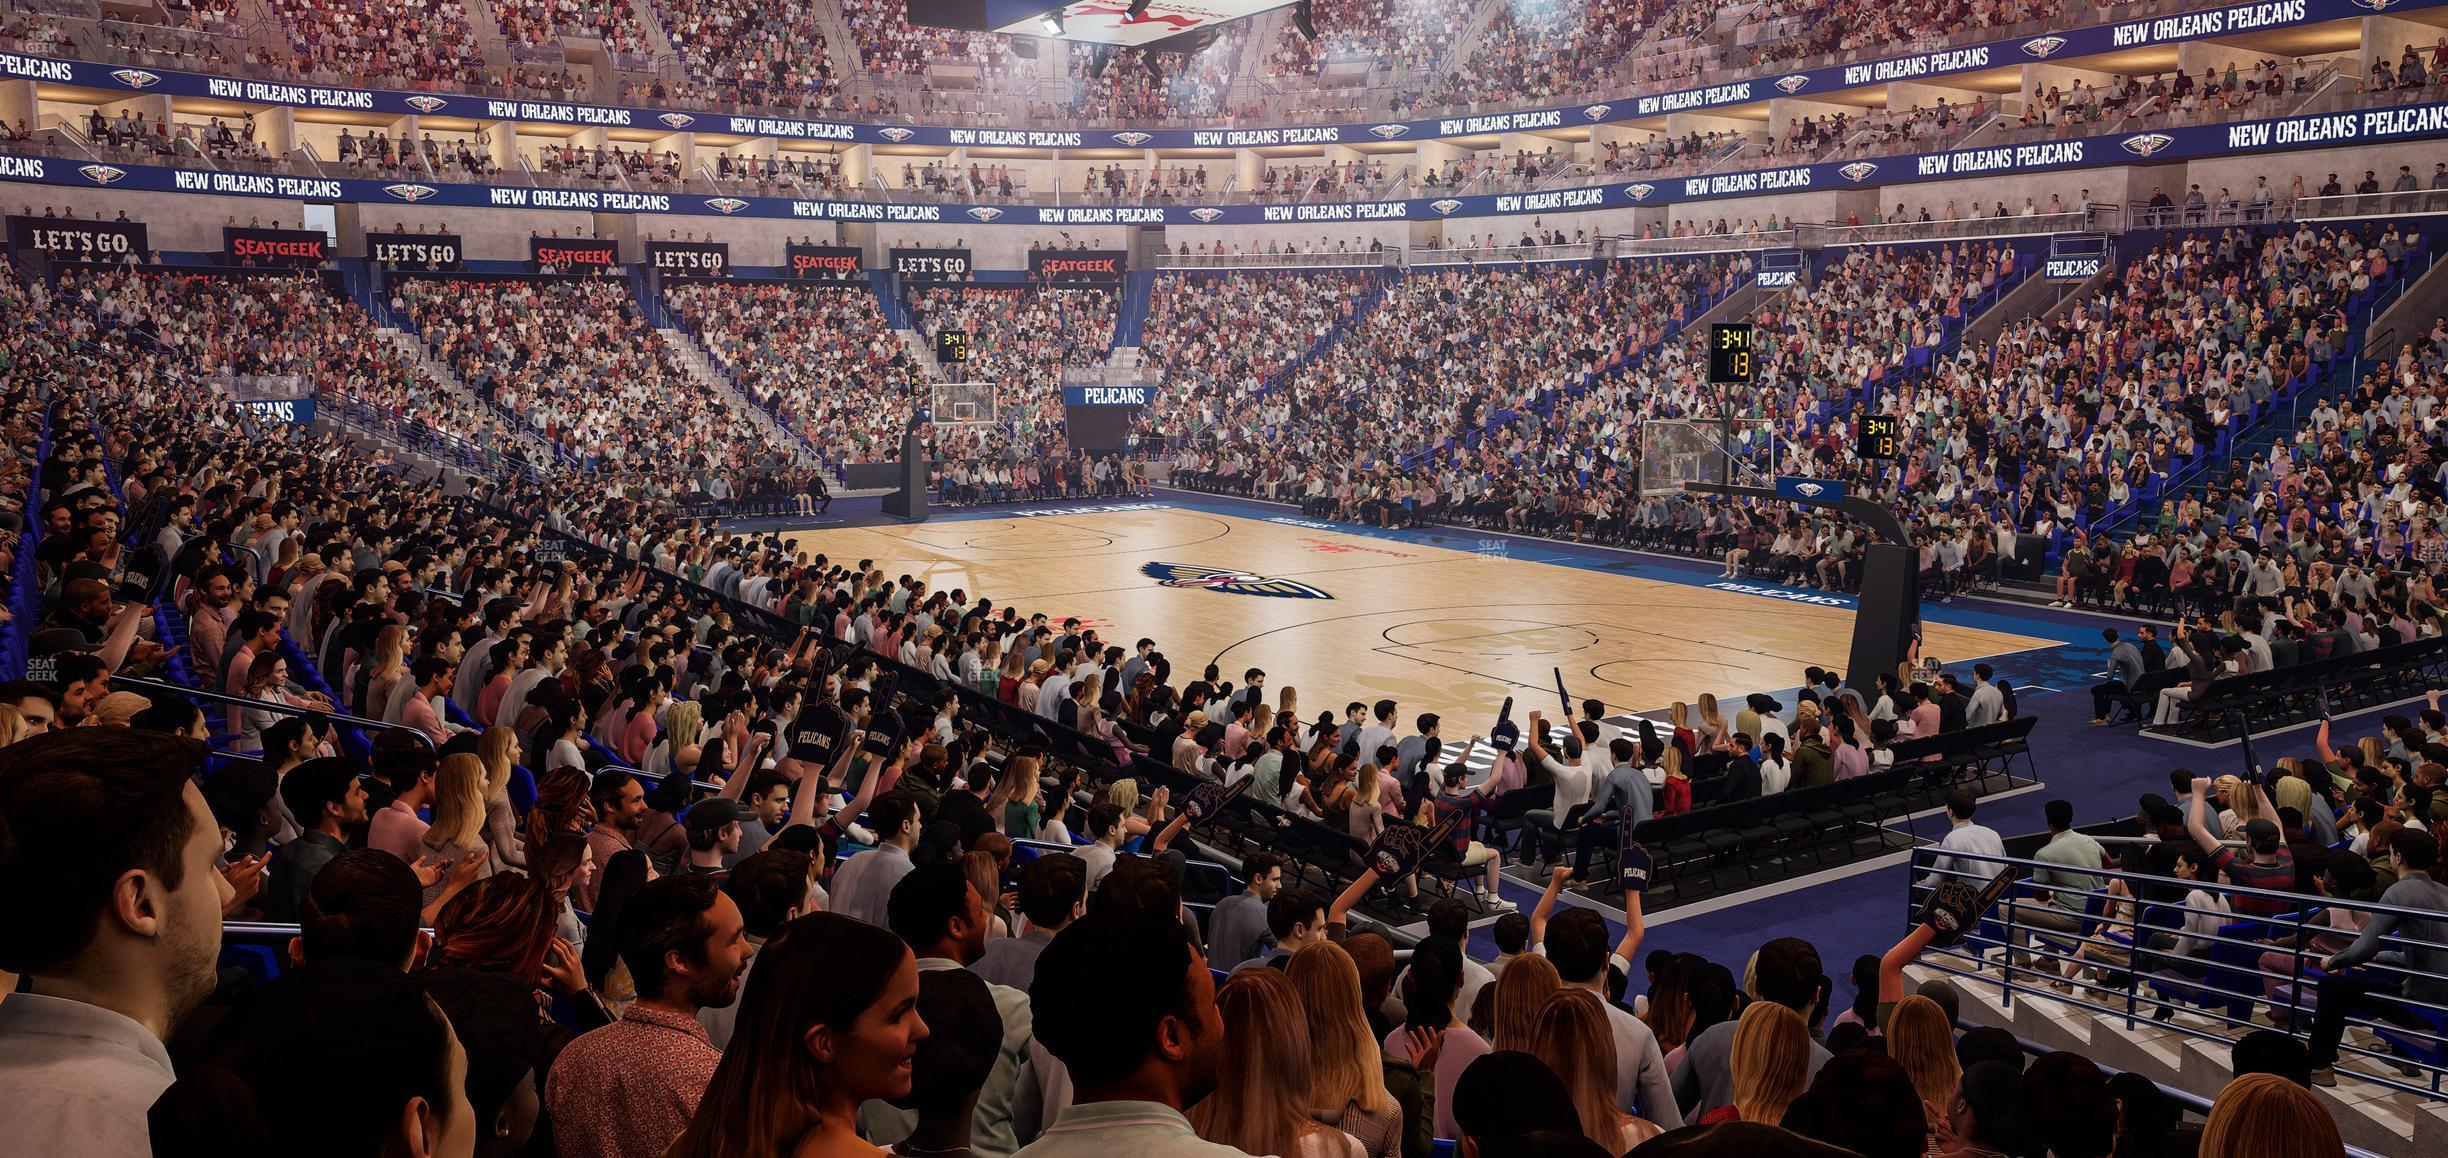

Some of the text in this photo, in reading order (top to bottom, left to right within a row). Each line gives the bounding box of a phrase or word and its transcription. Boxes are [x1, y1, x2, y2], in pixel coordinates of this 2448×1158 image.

[2113, 0, 2306, 47] NEW ORLEANS PELICANS
[1844, 46, 1989, 85] NEW ORLEANS PELICANS
[208, 78, 373, 109] NEW ORLEANS PELICANS
[1635, 82, 1751, 115] NEW ORLEANS PELICANS
[487, 100, 631, 125] NEW ORLEANS PELICANS
[729, 117, 855, 140] NEW ORLEANS PELICANS
[1440, 111, 1561, 135] NEW ORLEANS PELICANS
[2228, 122, 2272, 148] NEW
[2275, 114, 2358, 144] ORLEANS
[949, 129, 1082, 147] NEW ORLEANS PELICANS
[1193, 127, 1339, 146] NEW ORLEANS PELICANS
[0, 156, 44, 179] ICANS
[1918, 141, 2083, 176] NEW ORLEANS PELICANS
[174, 170, 342, 198] NEW ORLEANS PELICANS
[1685, 167, 1811, 196] NEW ORLEANS PELICANS
[490, 188, 670, 211] NEW ORLEANS PELICANS
[1496, 187, 1603, 212] NEW ORLEANS PELICANS
[792, 201, 940, 221] NEW ORLEANS PELICANS
[1038, 207, 1165, 223] NEW ORLEANS PELICANS
[1263, 201, 1407, 225] NEW ORLEANS PELICANS
[33, 229, 129, 253] LET'S GO
[234, 238, 323, 259] SEATGEEK
[375, 243, 455, 263] LET'S GO
[537, 247, 614, 265] SEATGEEK
[654, 251, 723, 269] LET'S GO
[898, 257, 966, 273] LET'S GO
[1041, 258, 1115, 273] SEATGEEK
[2046, 259, 2098, 277] PELICANS
[945, 333, 965, 345] 3:41
[1722, 329, 1750, 349] 3:41
[955, 346, 965, 360] 13
[1734, 352, 1749, 377] 13
[1085, 387, 1144, 404] PELICANS
[1868, 419, 1894, 435] 3:41
[1879, 437, 1893, 456] 13
[125, 571, 149, 589] PELICANS
[1705, 582, 1851, 605] PELICANS
[797, 731, 831, 750] PELICANS
[868, 731, 890, 746] PELICANS
[1623, 867, 1647, 880] PELICANS
